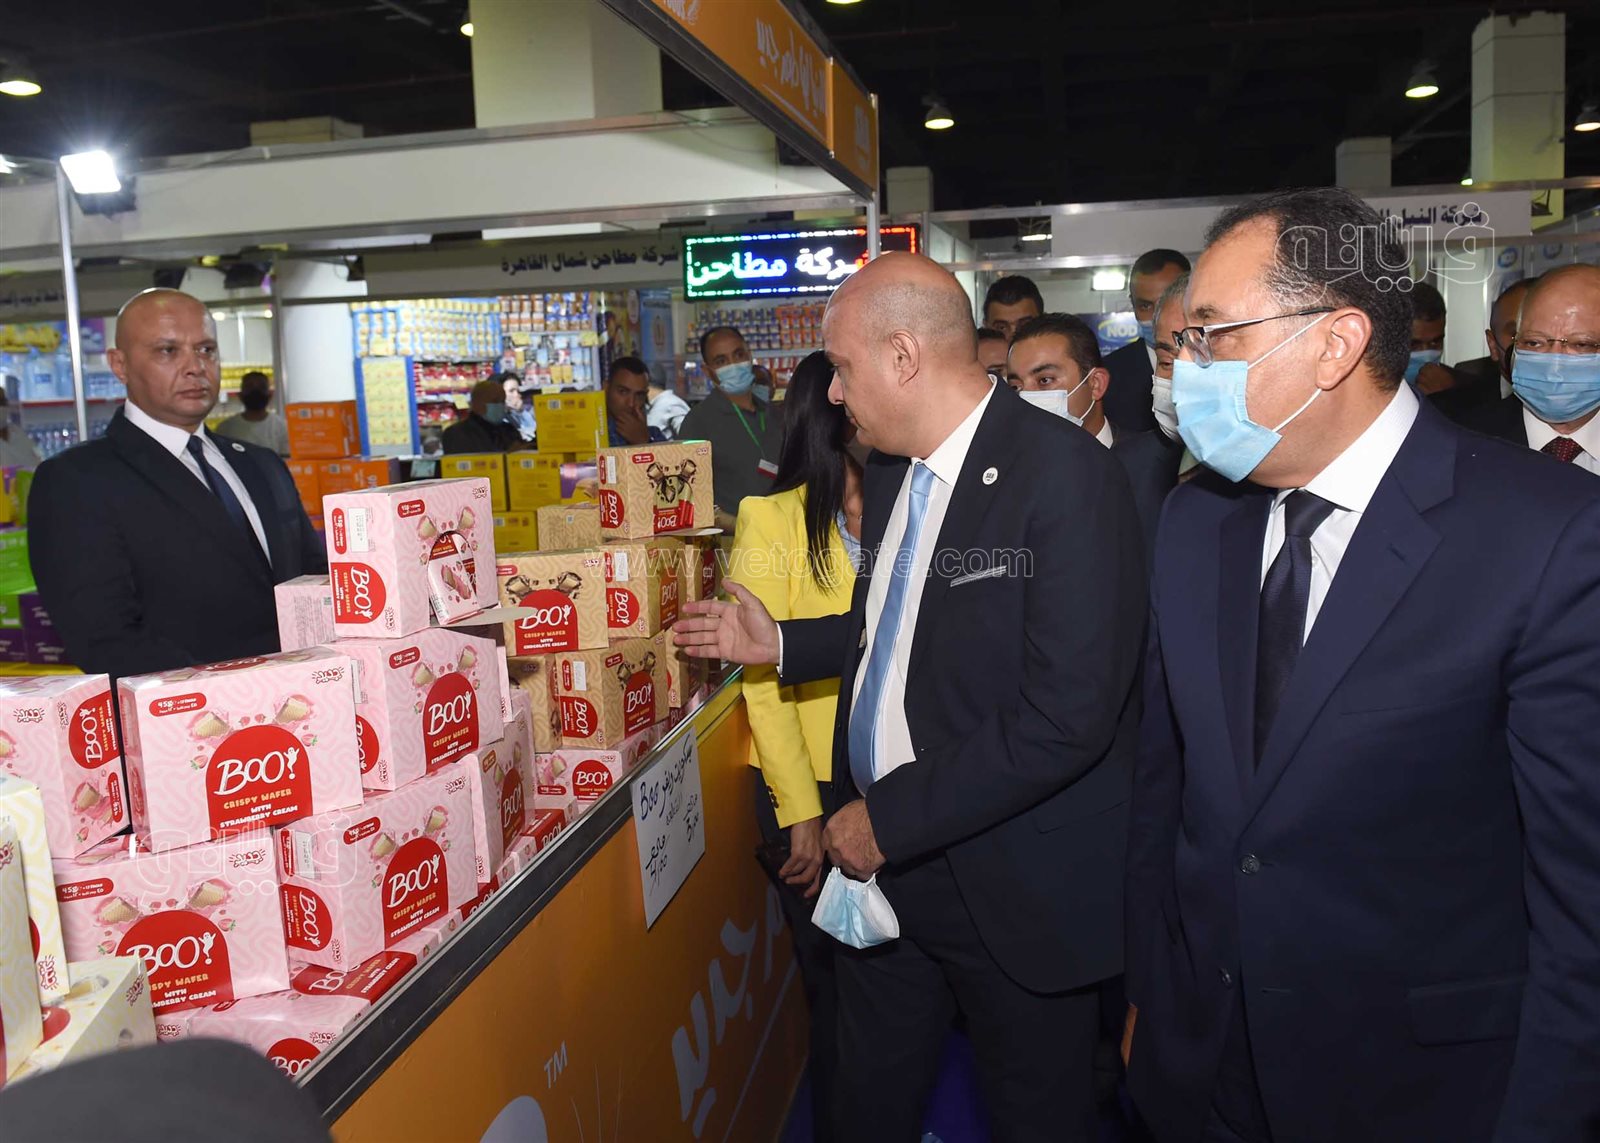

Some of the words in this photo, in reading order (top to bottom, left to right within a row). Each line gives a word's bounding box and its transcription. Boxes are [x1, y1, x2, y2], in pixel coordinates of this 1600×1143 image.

[1402, 206, 1437, 229] النيل
[1441, 205, 1482, 226] شركة
[502, 253, 548, 276] القاهرة
[552, 251, 588, 272] شمال
[591, 249, 637, 270] مطاحن
[642, 247, 679, 265] شركة
[690, 252, 788, 286] مطاحن
[351, 566, 373, 619] BOO!
[519, 604, 572, 629] BOO!
[615, 591, 630, 625] BOO!
[626, 683, 652, 713] BOO!
[427, 691, 472, 736] BOO!
[574, 700, 589, 735] BOO!
[79, 707, 103, 764] BOO!
[433, 734, 452, 748] CRISPY
[452, 727, 469, 739] WAFER
[431, 748, 458, 764] STRAWBERRY
[458, 741, 472, 752] CREAM
[213, 746, 300, 796] BOO!
[575, 771, 609, 786] BOO!
[223, 796, 258, 810] CRISPY
[261, 788, 292, 801] WAFER
[251, 803, 272, 814] WITH
[502, 783, 522, 828] BOO!
[219, 812, 272, 829] STRAWBERRY
[272, 805, 298, 816] CREAM
[387, 853, 440, 908] BOO!
[393, 904, 416, 920] CRISPY
[416, 892, 437, 905] WAFER
[410, 909, 424, 920] WITH
[299, 891, 321, 947] BOO!
[390, 915, 423, 938] STRAWBERRY
[423, 906, 440, 919] CREAM
[127, 931, 216, 975] BOO!
[151, 980, 172, 991] SPY
[175, 973, 209, 986] WAFER
[164, 988, 187, 998] WITH
[153, 996, 187, 1008] WBERRY
[188, 990, 216, 1001] CREAM
[544, 1040, 568, 1089] TM
